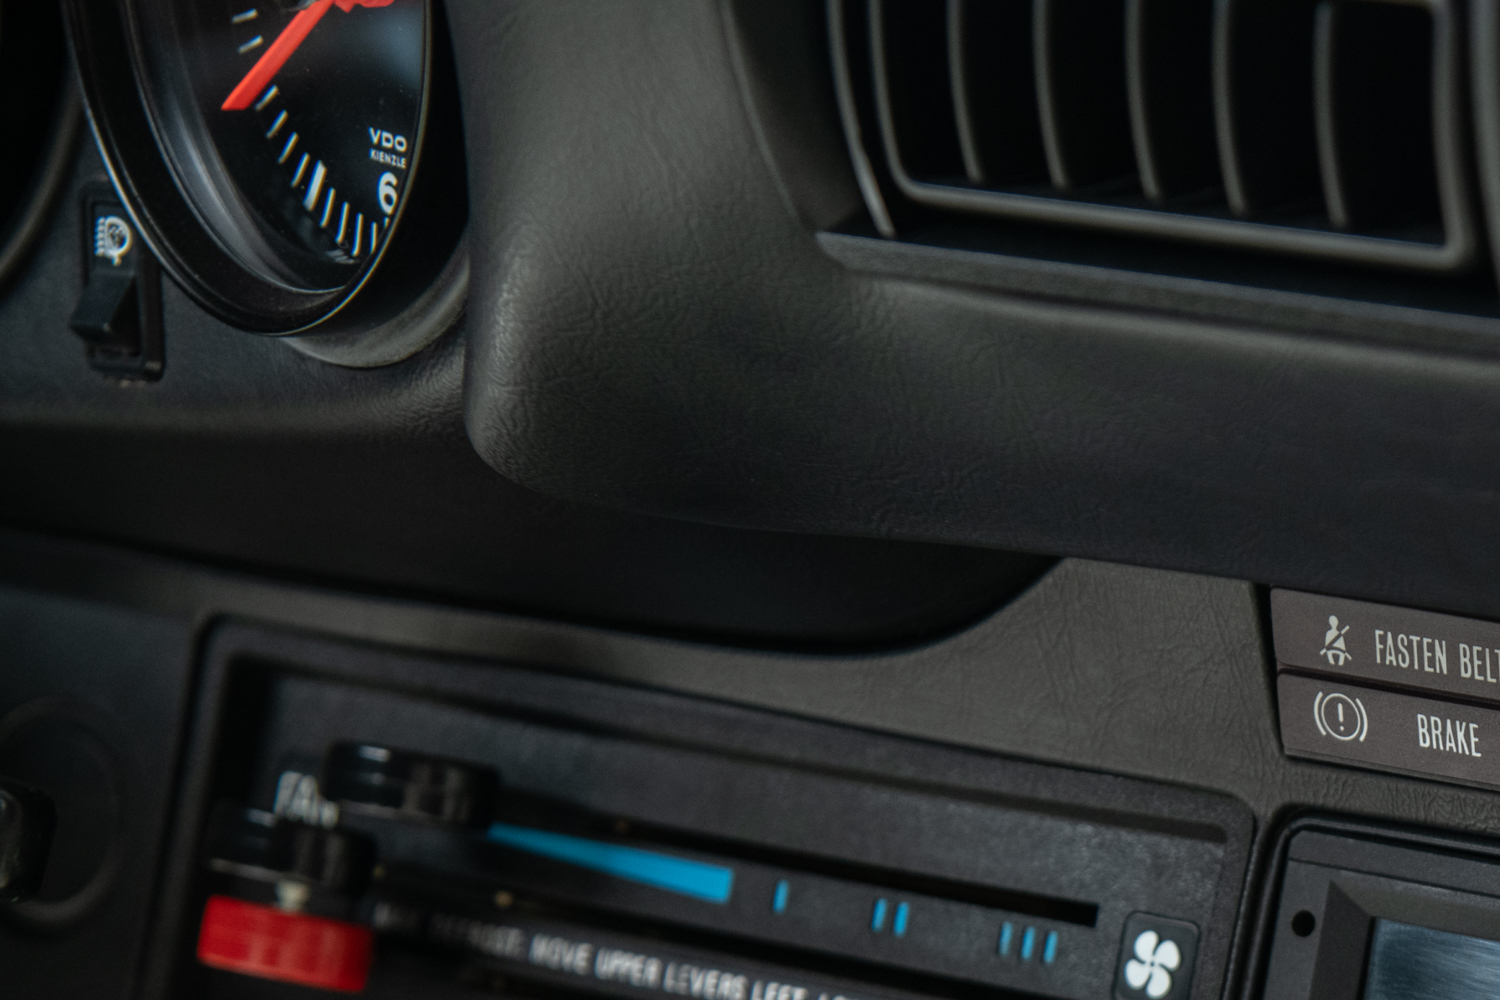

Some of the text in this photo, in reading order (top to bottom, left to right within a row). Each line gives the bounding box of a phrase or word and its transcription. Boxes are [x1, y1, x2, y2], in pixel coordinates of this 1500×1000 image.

[368, 127, 407, 153] VDO
[369, 148, 407, 169] KIENZLE
[377, 171, 399, 215] 6
[1374, 629, 1448, 675] FASTEN
[1417, 713, 1481, 757] BRAKE
[529, 934, 591, 978] MOVE
[594, 946, 663, 989] UPPER
